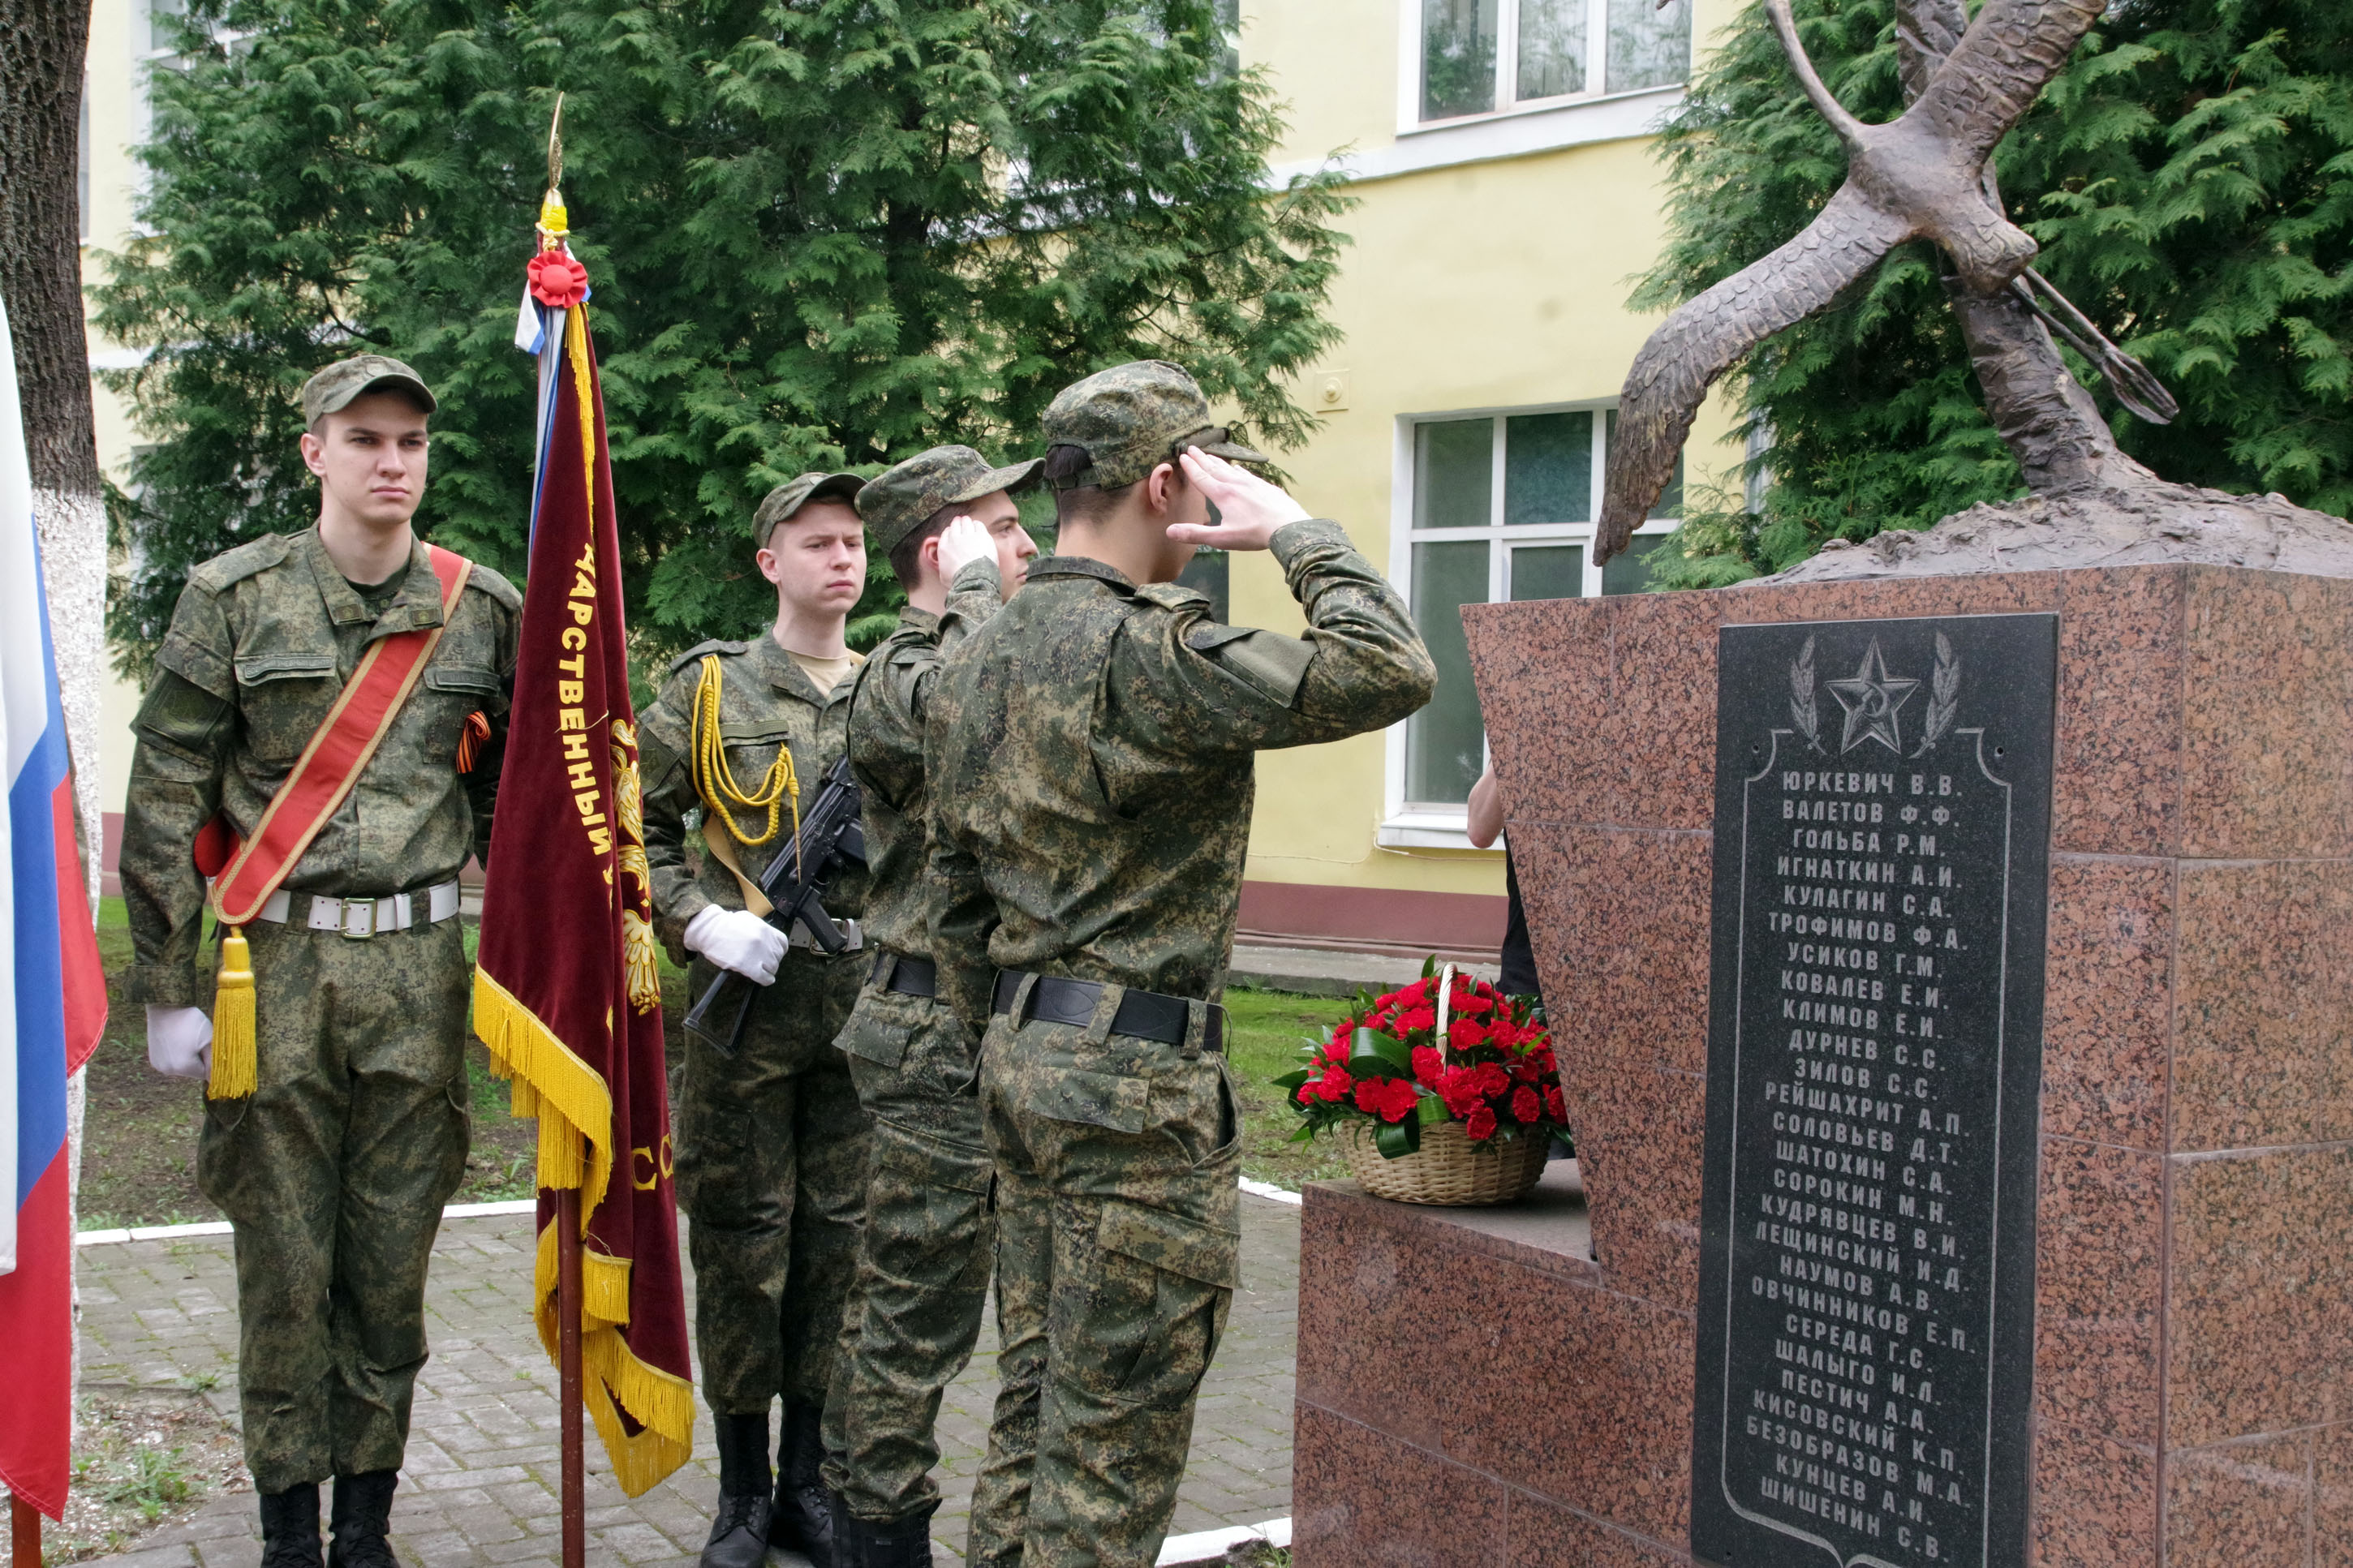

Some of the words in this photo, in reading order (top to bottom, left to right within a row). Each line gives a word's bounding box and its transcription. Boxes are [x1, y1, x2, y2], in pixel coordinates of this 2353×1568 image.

[1783, 771, 1893, 793] ЮРКЕВИЧ
[1912, 774, 1962, 797] В.В.
[1783, 800, 1882, 823] ВАЛЕТОВ
[1900, 805, 1959, 827] Ф.Ф.
[1793, 828, 1880, 853] ГОЛЬБА
[1897, 833, 1945, 857] Р.М.
[1778, 857, 1895, 883] ИГНАТКИН
[1911, 865, 1962, 888] А.И.
[1784, 885, 1885, 912] КУЛАГИН
[1903, 894, 1951, 918] С.А.
[1769, 912, 1896, 943] ТРОФИМОВ
[1913, 926, 1967, 950] Ф.А.
[1787, 942, 1878, 970] УСИКОВ
[1895, 953, 1942, 977] Г.М.
[1781, 970, 1883, 1001] КОВАЛЕВ
[1901, 984, 1948, 1009] Е.И.
[1783, 999, 1878, 1029] КЛИМОВ
[1895, 1013, 1942, 1039] Е.И.
[1788, 1029, 1878, 1060] ДУРНЕВ
[1895, 1045, 1945, 1071] С.С.
[1795, 1058, 1869, 1088] ЗИЛОВ
[1887, 1073, 1938, 1100] С.С.
[1766, 1080, 1903, 1123] РЕЙШАХРИТ
[1918, 1108, 1969, 1136] А.П.
[1773, 1111, 1894, 1152] СОЛОВЬЕВ
[1910, 1137, 1958, 1166] Д.Т.
[1776, 1140, 1885, 1180] ШАТОХИН
[1903, 1166, 1952, 1195] С.А.
[1774, 1168, 1882, 1209] СОРОКИН
[1899, 1195, 1952, 1226] М.Н.
[1762, 1193, 1896, 1242] КУДРЯВЦЕВ
[1914, 1228, 1965, 1260] В.И.
[1756, 1221, 1899, 1274] ЛЕЩИНСКИЙ
[1917, 1259, 1969, 1293] И.Д.
[1780, 1255, 1873, 1295] НАУМОВ
[1890, 1282, 1938, 1314] А.В.
[1752, 1276, 1908, 1335] ОВЧИННИКОВ
[1926, 1321, 1975, 1354] Е.П.
[1786, 1313, 1873, 1355] СЕРЕДА
[1889, 1341, 1933, 1373] Г.С.
[1775, 1339, 1875, 1385] ШАЛЫГО
[1892, 1372, 1942, 1406] И.Л.
[1782, 1369, 1868, 1413] ПЕСТИЧ
[1885, 1401, 1933, 1433] А.А.
[1753, 1389, 1895, 1452] КИСОВСКИЙ
[1912, 1439, 1964, 1476] К.П.
[1747, 1415, 1899, 1483] БЕЗОБРАЗОВ
[1916, 1471, 1970, 1508] М.А.
[1777, 1454, 1866, 1501] КУНЦЕВ
[1882, 1490, 1932, 1525] А.И.
[1761, 1476, 1880, 1537] ШИШЕНИН
[1898, 1526, 1948, 1562] С.В.
